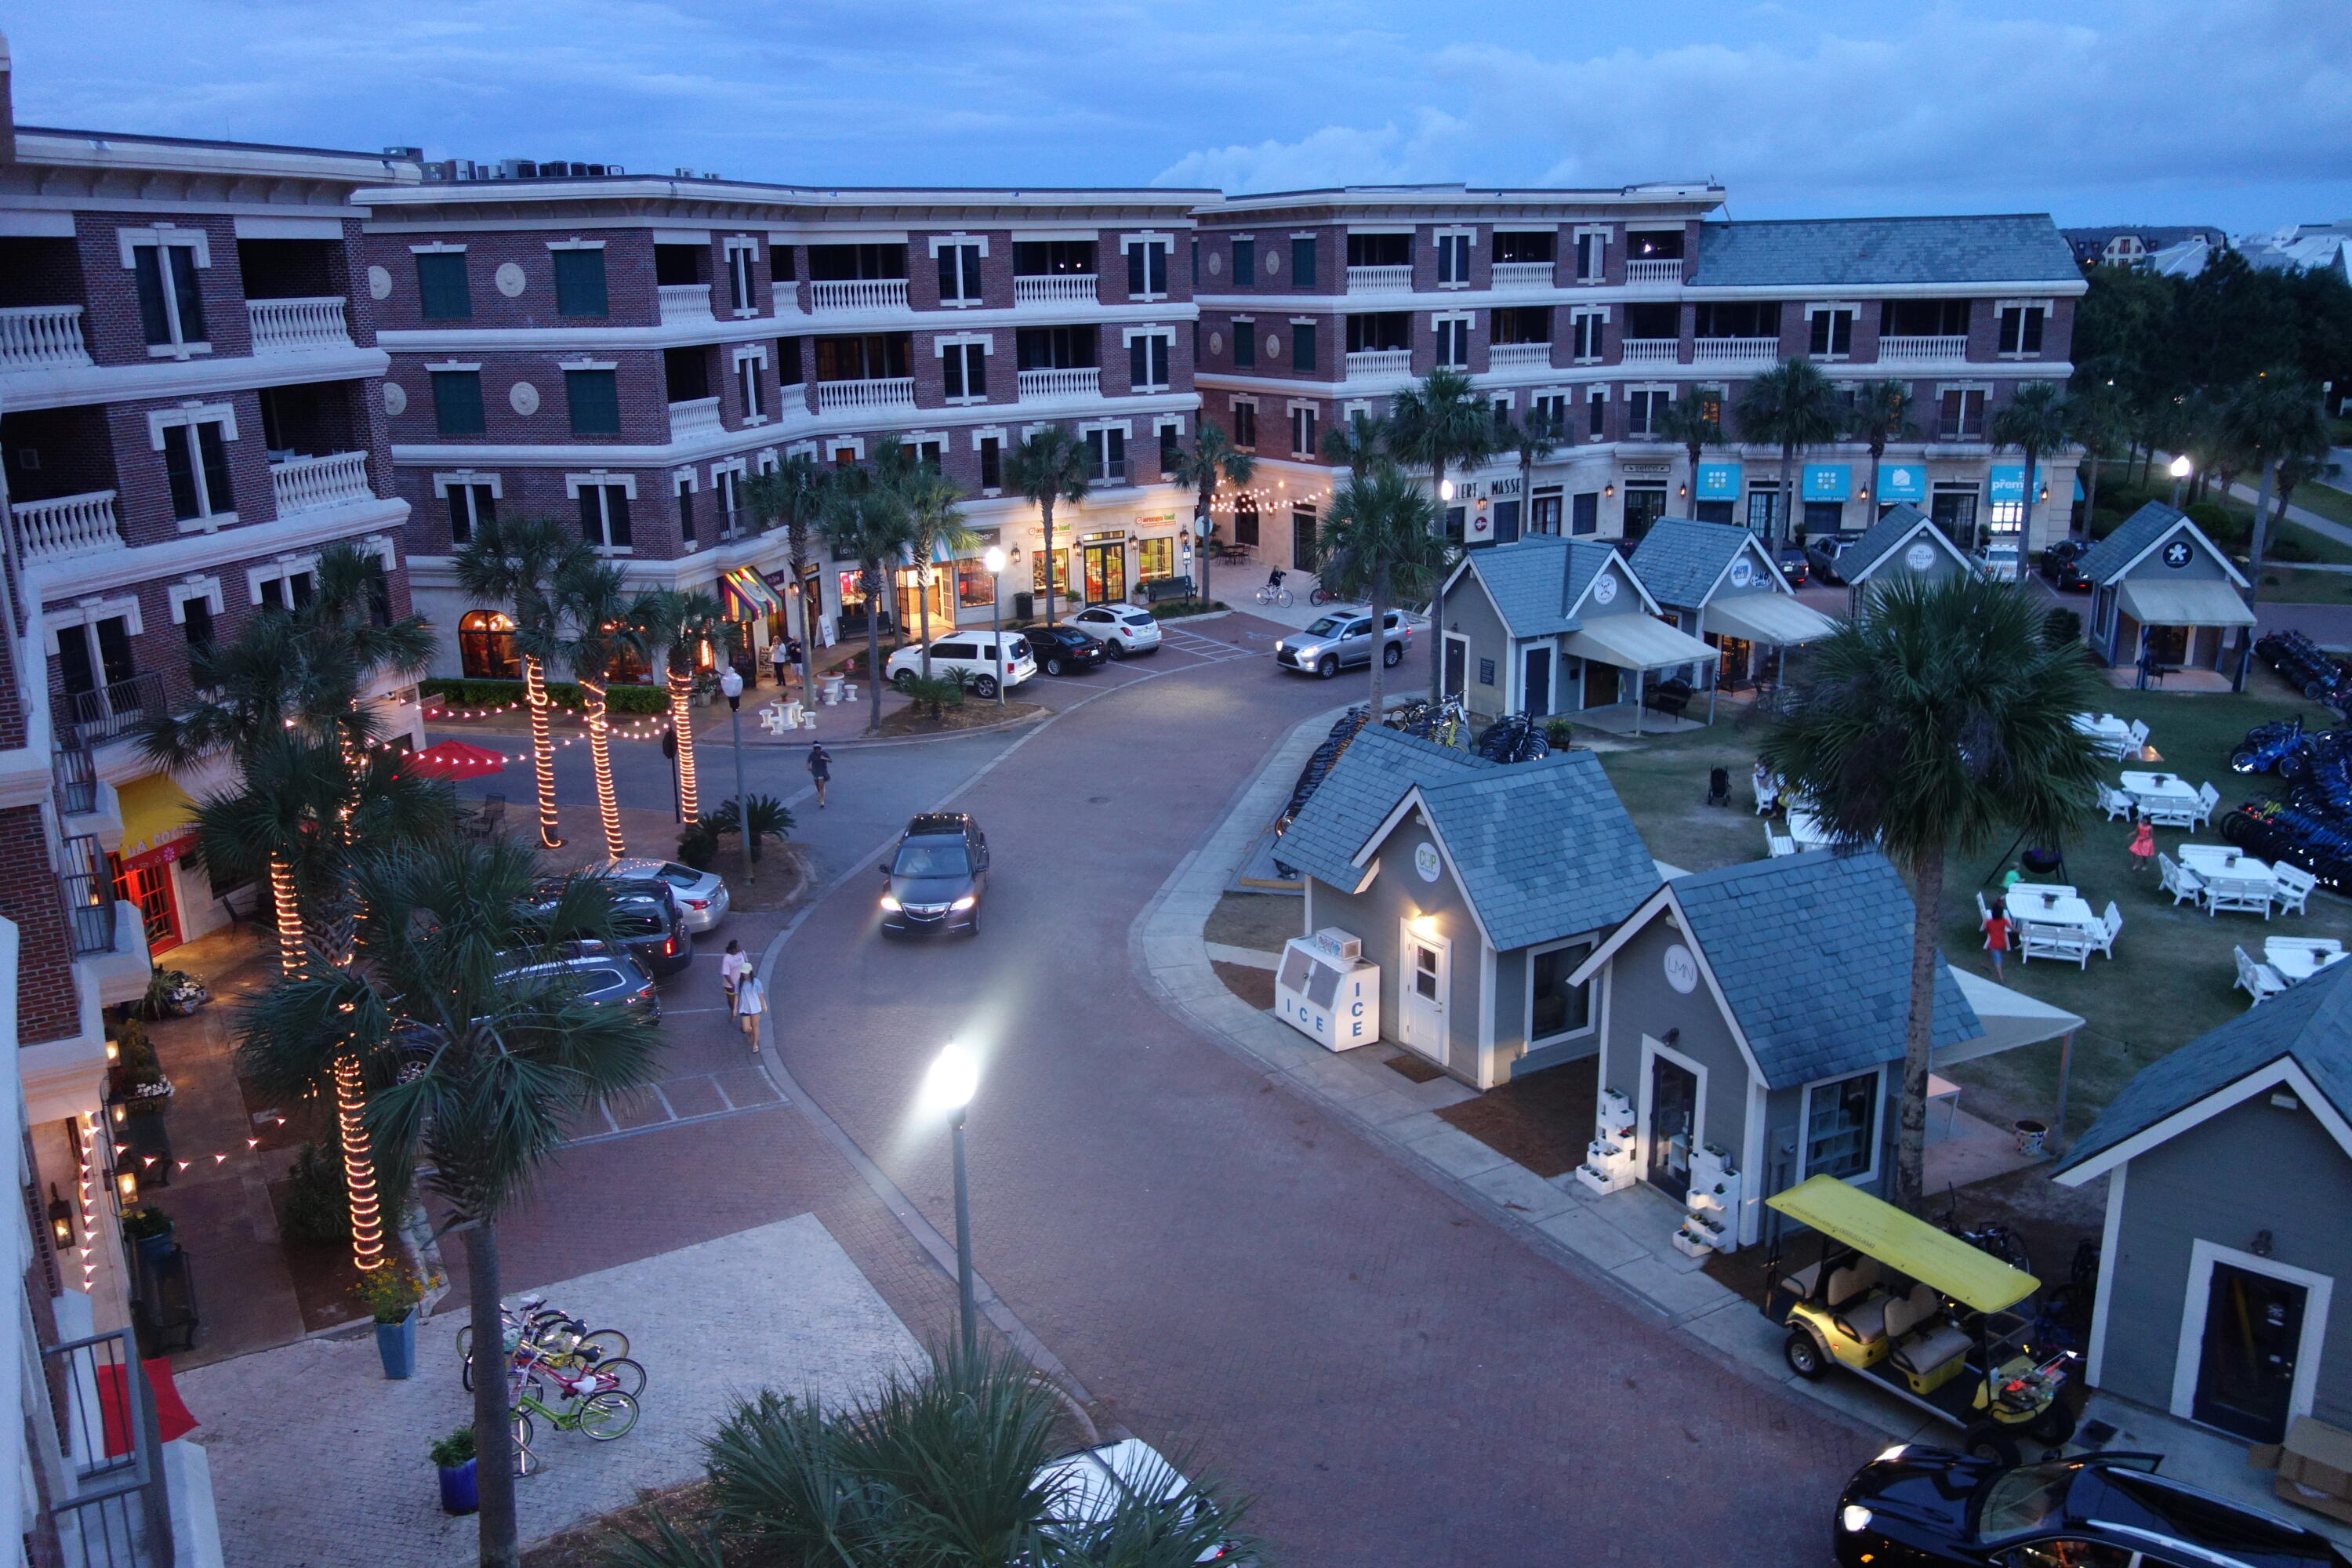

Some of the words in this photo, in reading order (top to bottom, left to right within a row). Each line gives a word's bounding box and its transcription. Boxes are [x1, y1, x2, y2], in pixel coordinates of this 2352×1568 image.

[126, 840, 148, 857] LA
[1287, 998, 1323, 1033] ICE
[1352, 982, 1363, 1037] ICE
